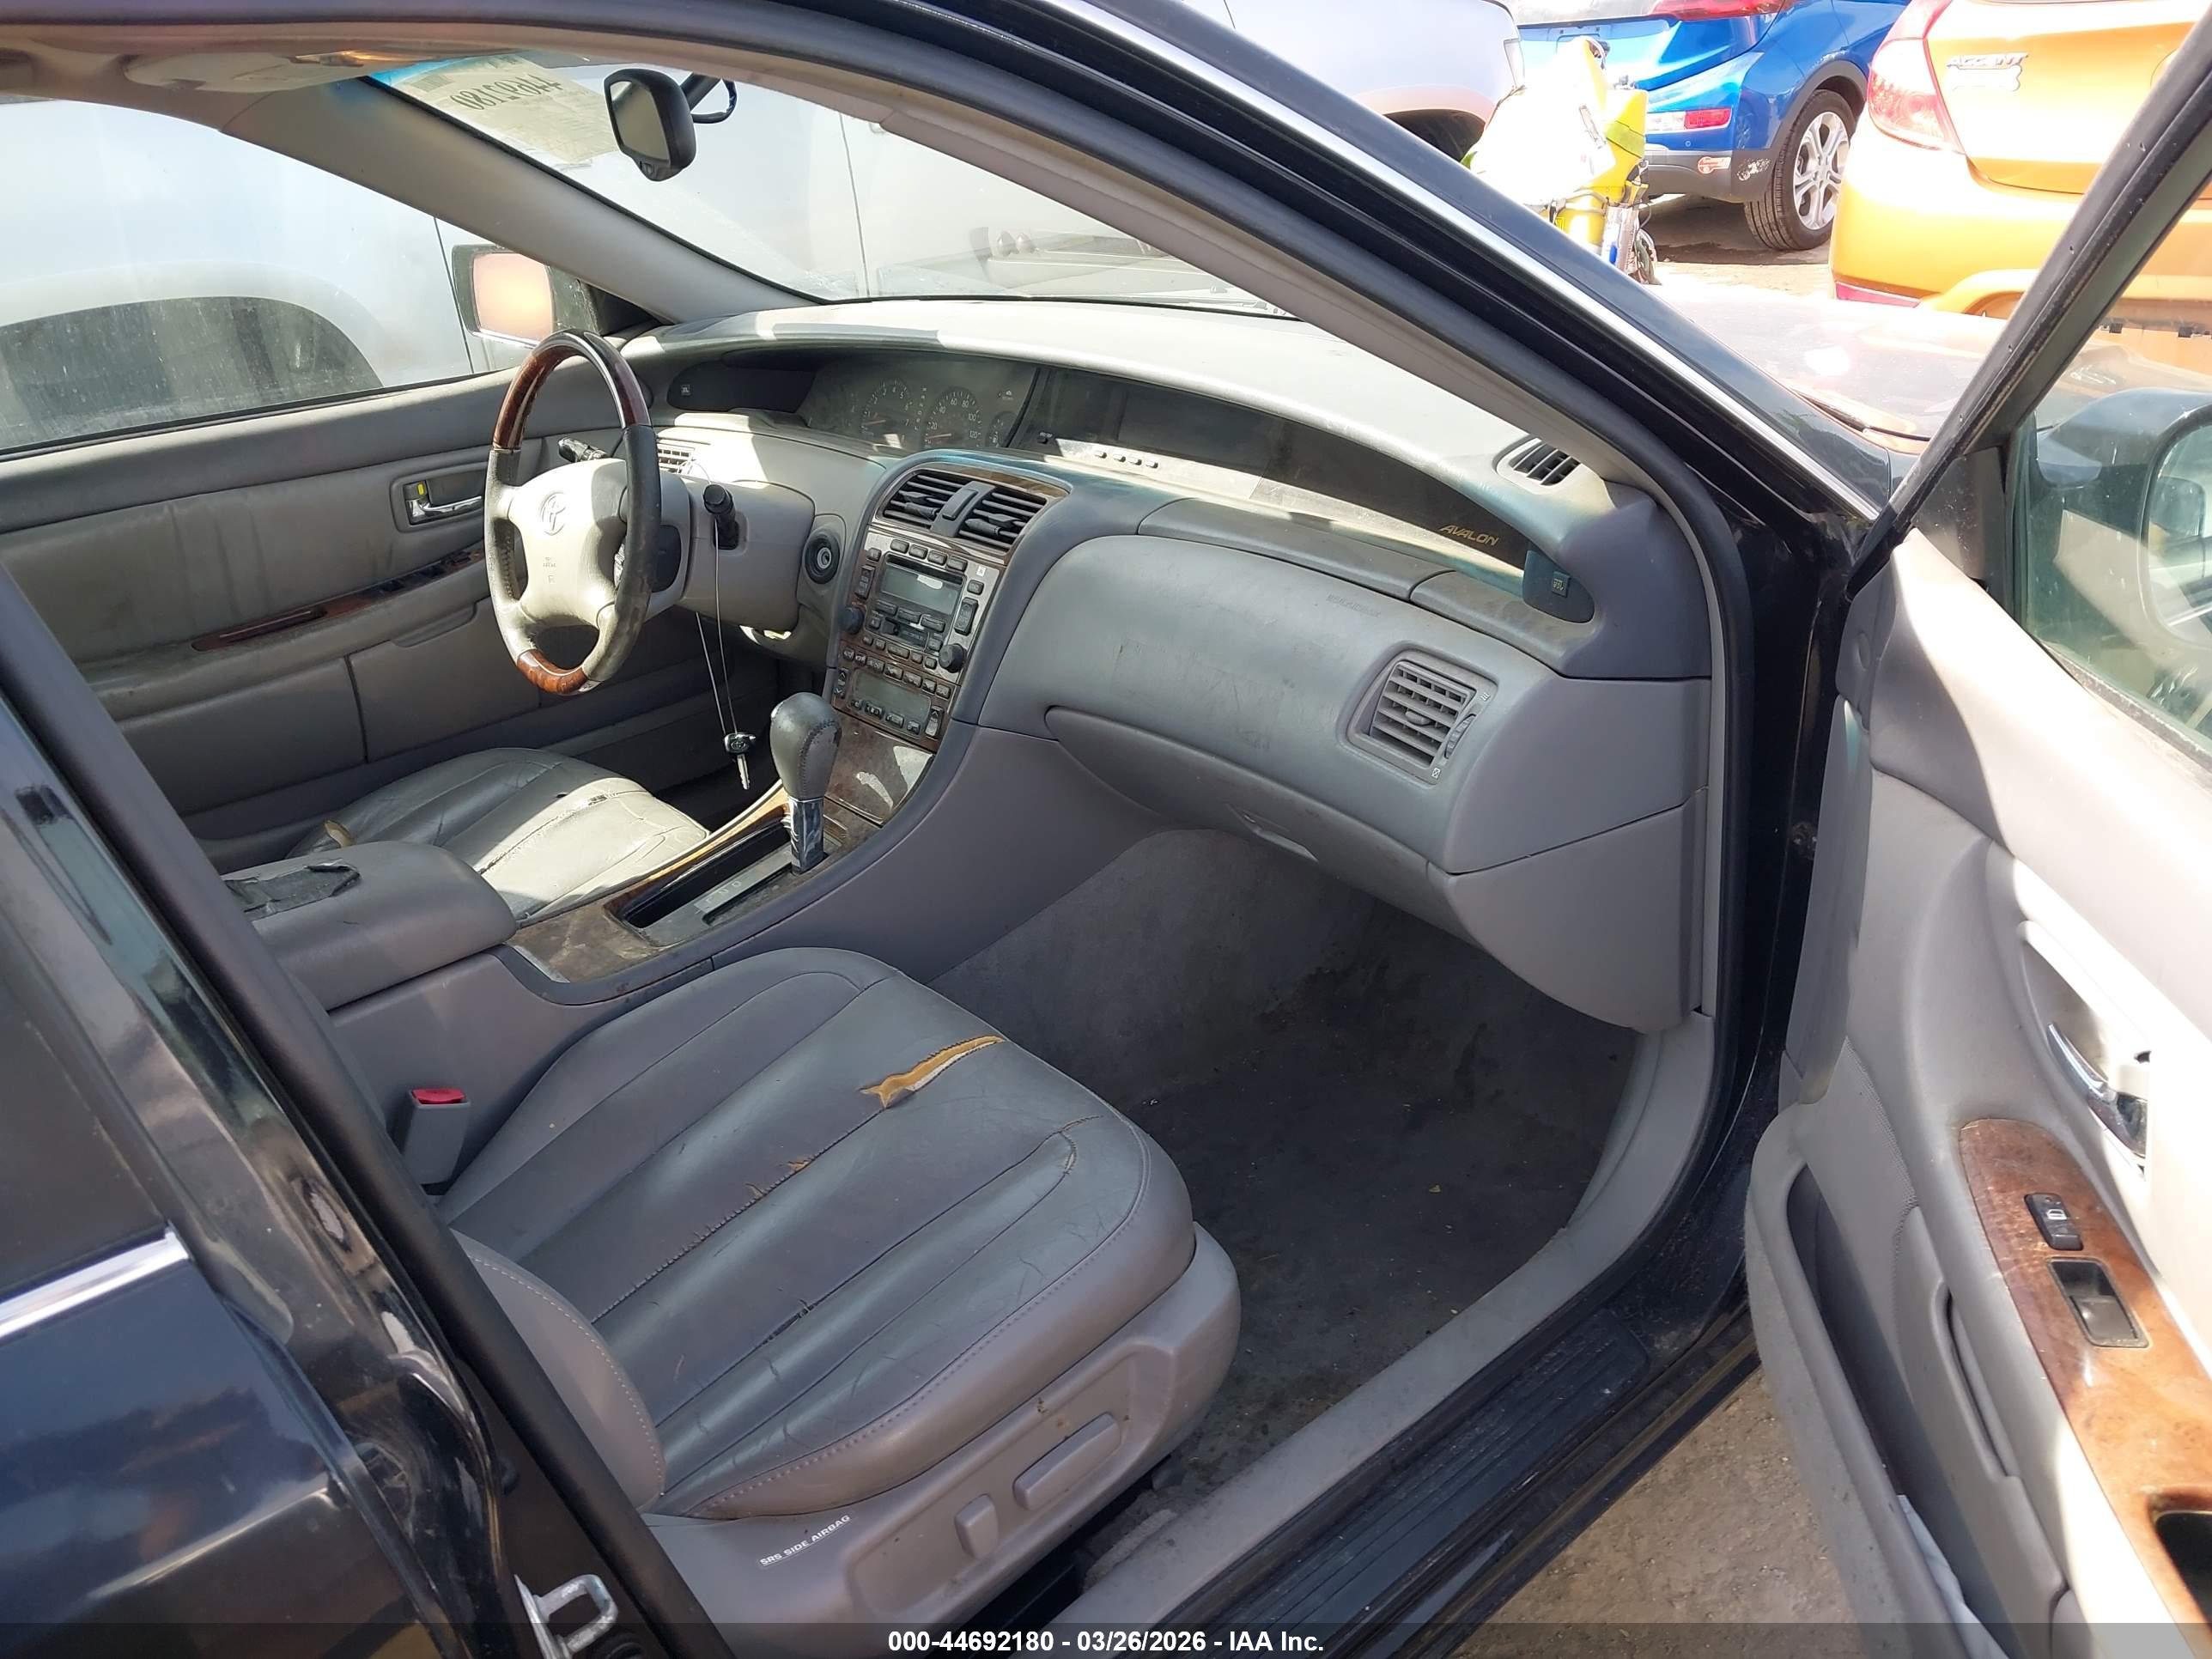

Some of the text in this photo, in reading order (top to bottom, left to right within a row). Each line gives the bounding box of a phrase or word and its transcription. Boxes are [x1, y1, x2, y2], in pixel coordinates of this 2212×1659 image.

[1440, 525, 1499, 546] AVALON
[760, 1553, 782, 1565] SRS
[783, 1540, 809, 1556] SIDE
